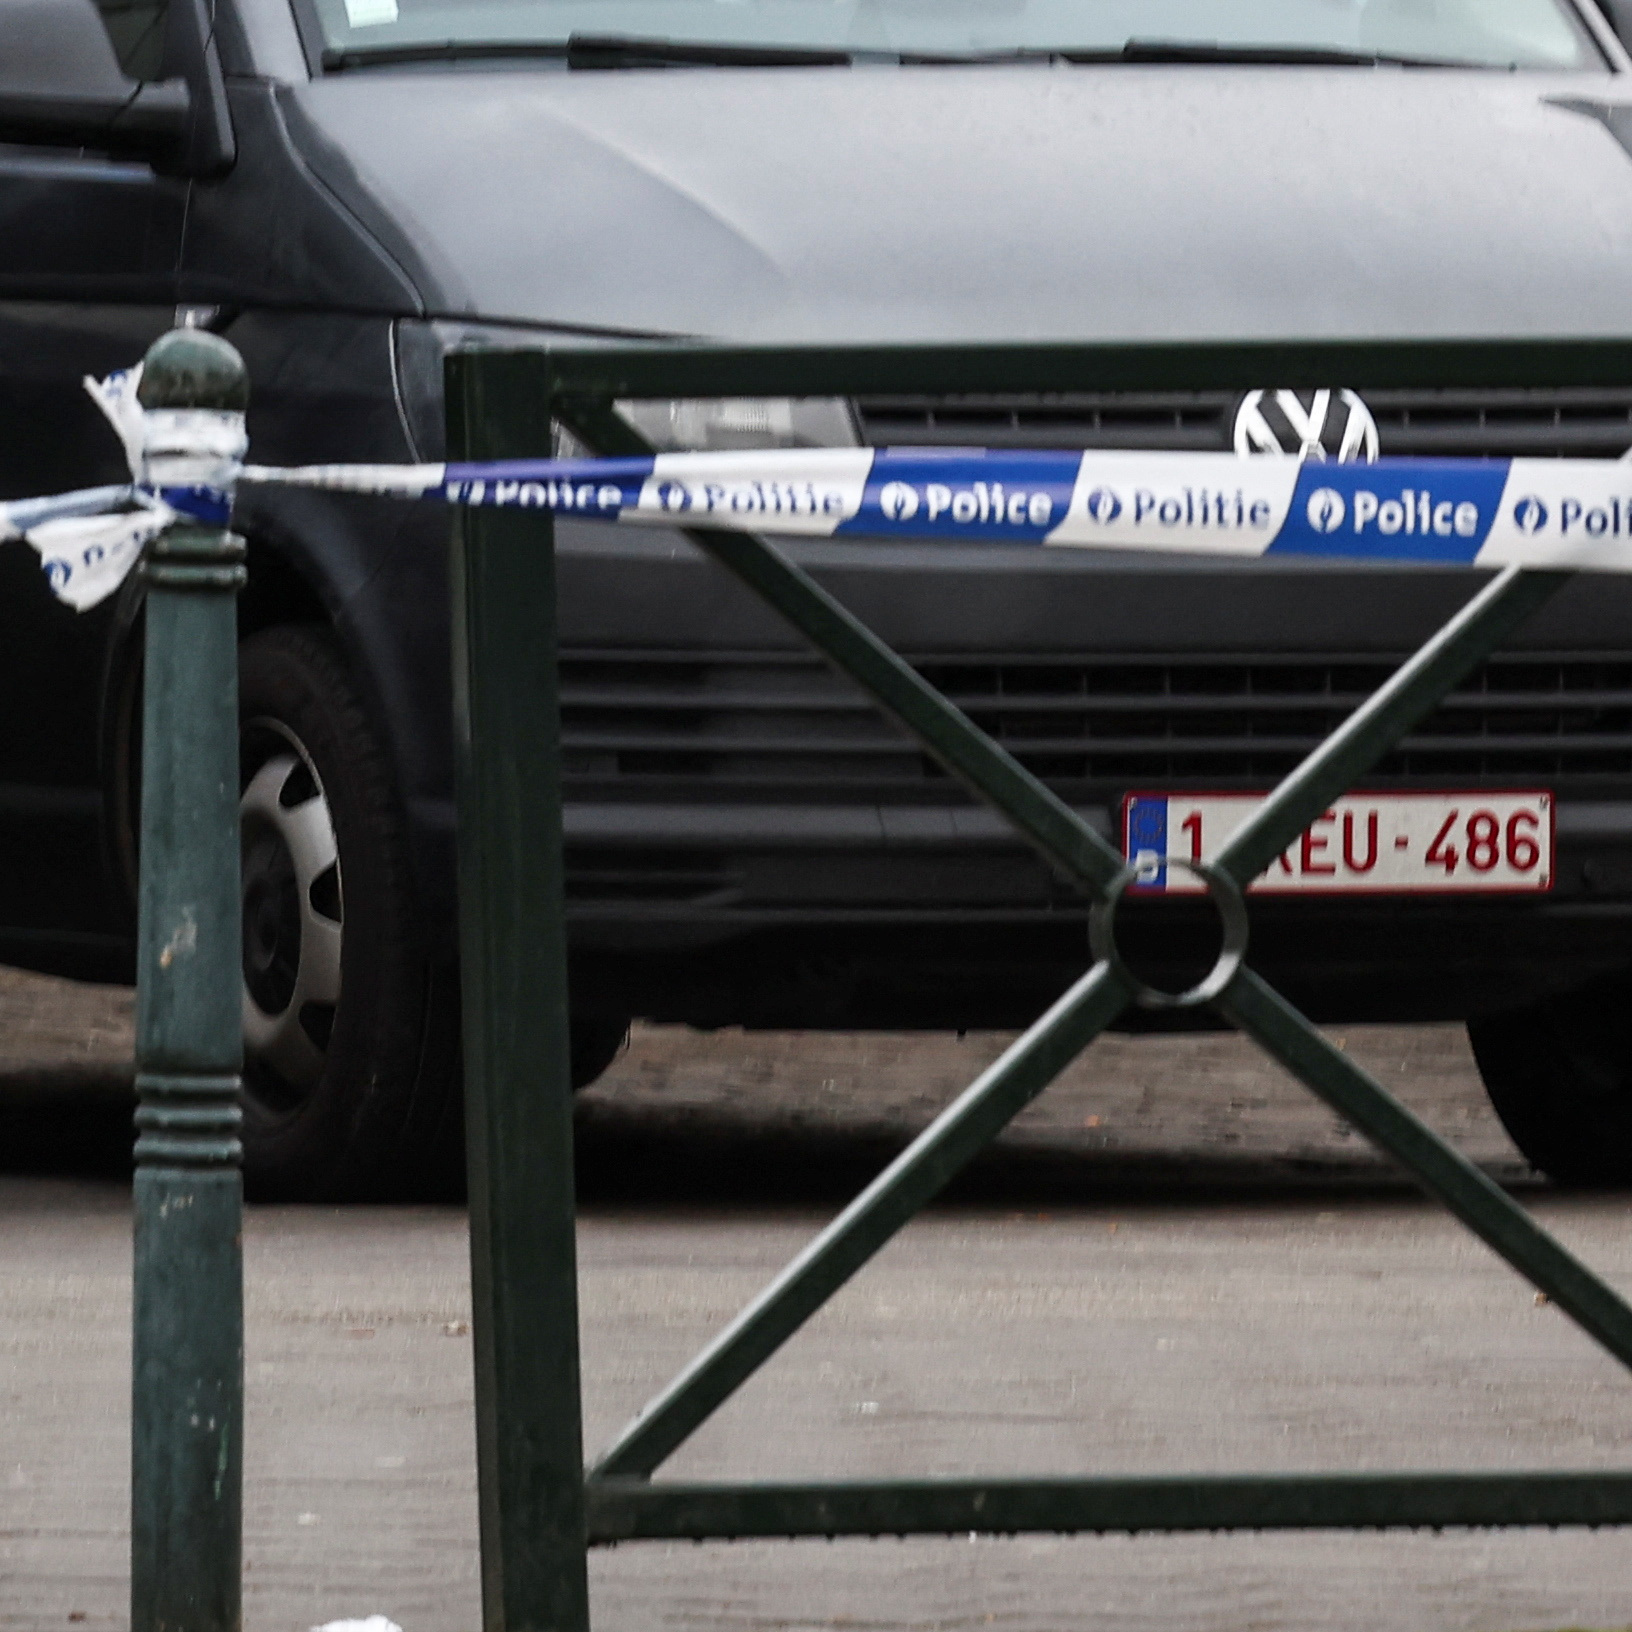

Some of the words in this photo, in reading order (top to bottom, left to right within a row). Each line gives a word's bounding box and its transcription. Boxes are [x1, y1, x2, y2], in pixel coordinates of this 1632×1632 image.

[704, 480, 844, 515] Politie
[925, 482, 1053, 525] Police
[1135, 487, 1271, 530] Politie
[1354, 489, 1479, 537] Police
[1181, 808, 1541, 877] 1EU-486
